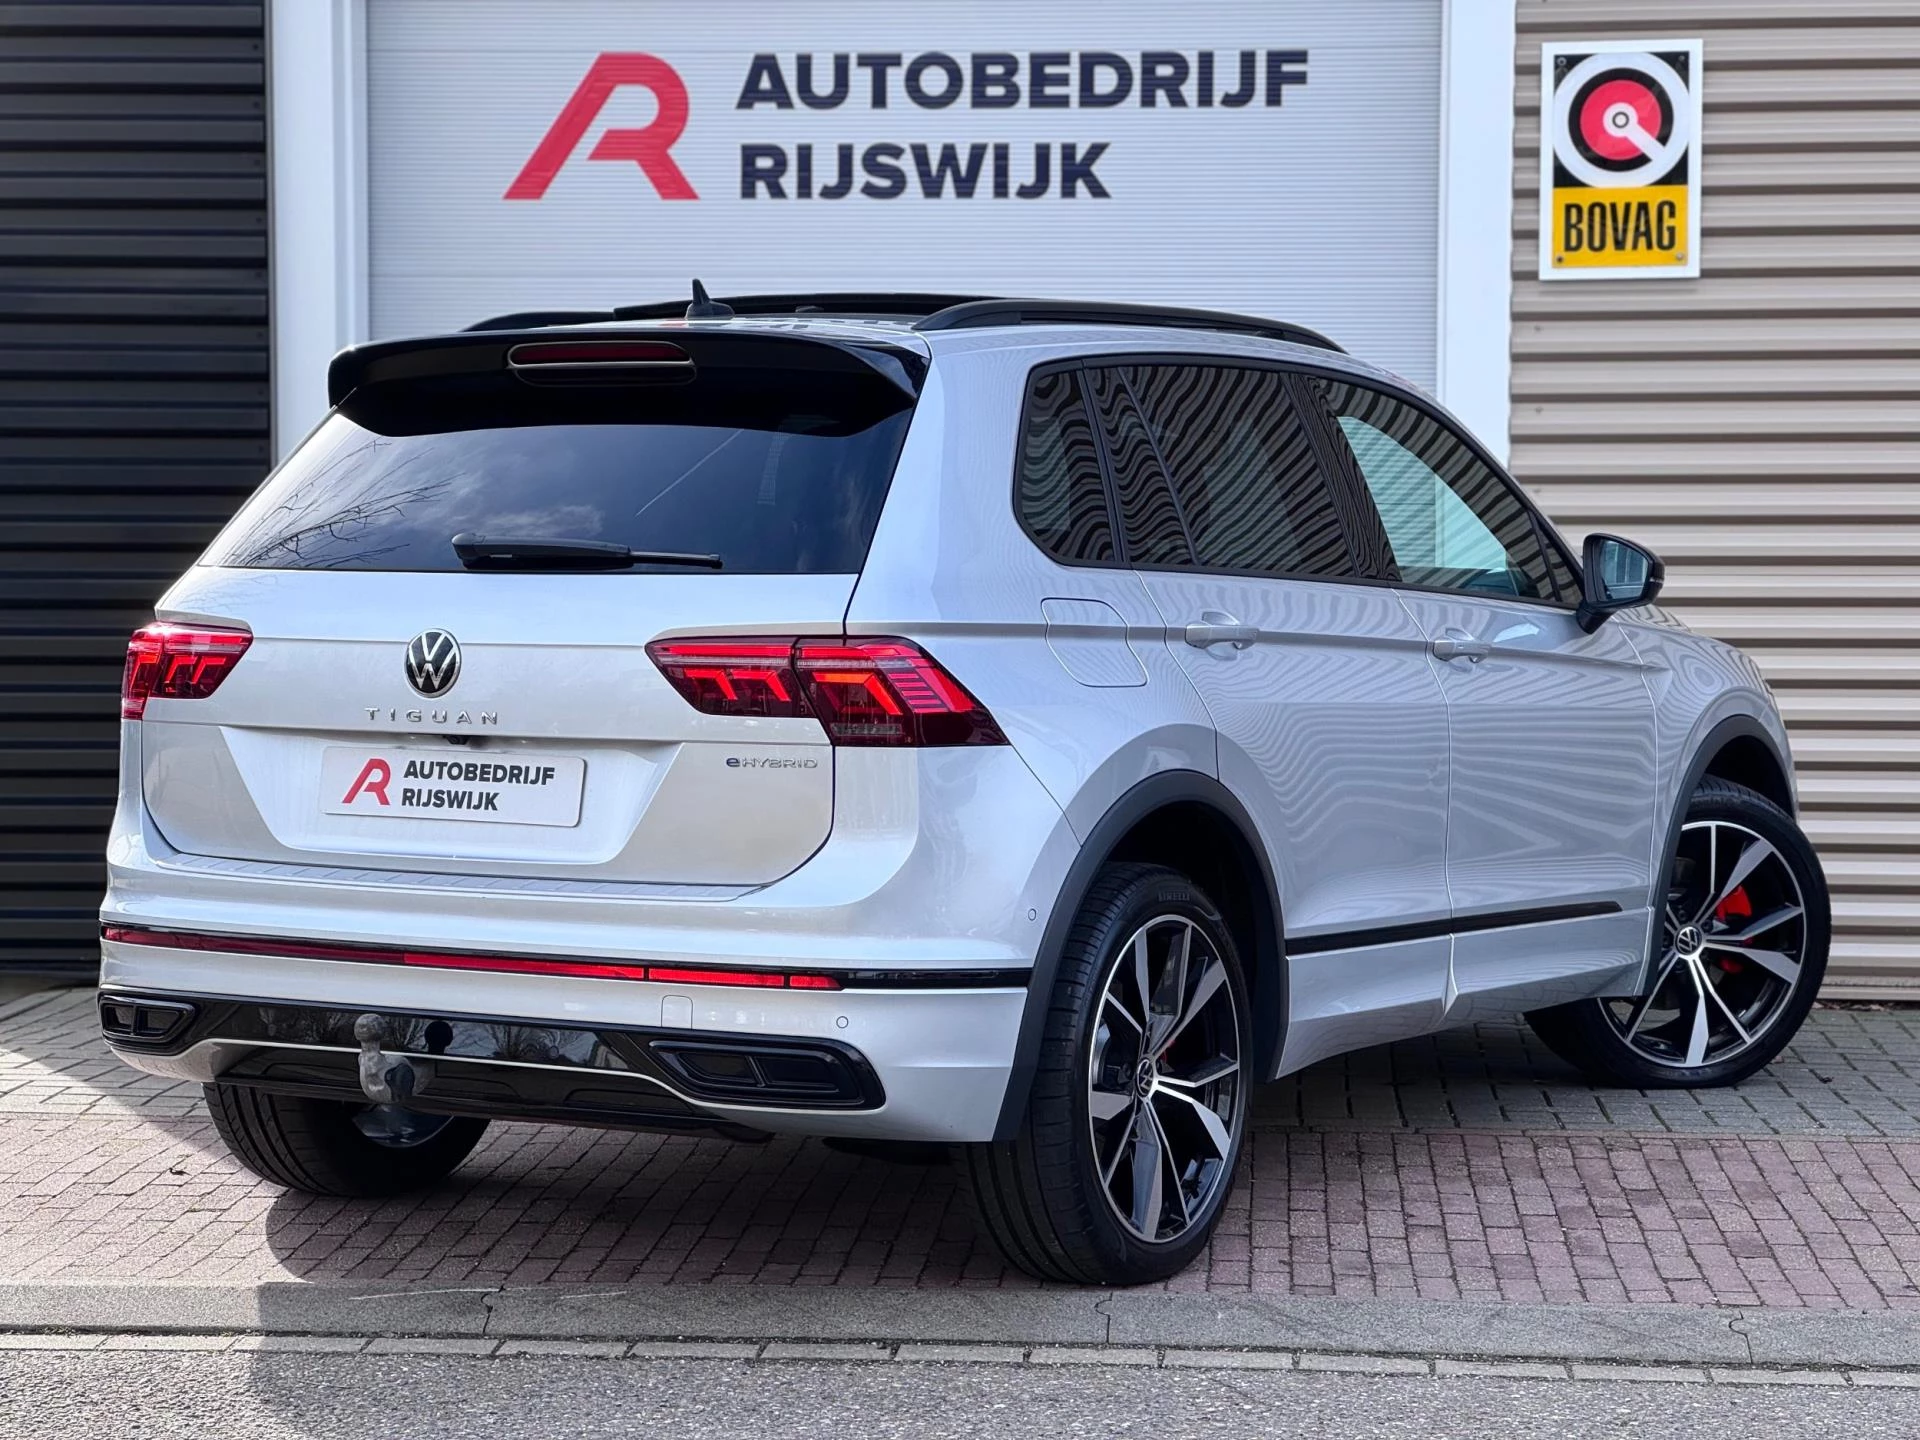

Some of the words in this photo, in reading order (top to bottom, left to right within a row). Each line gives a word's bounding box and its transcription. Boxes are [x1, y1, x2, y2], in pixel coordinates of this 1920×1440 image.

[735, 49, 1309, 110] AUTOBEDRIJF
[740, 142, 1111, 200] RIJSWIJK
[1563, 200, 1677, 253] BOVAG
[365, 706, 499, 725] TIGUAN
[403, 760, 555, 786] AUTOBEDRIJF
[725, 757, 818, 769] eHYBRID
[401, 788, 499, 811] RIJSWIJK
